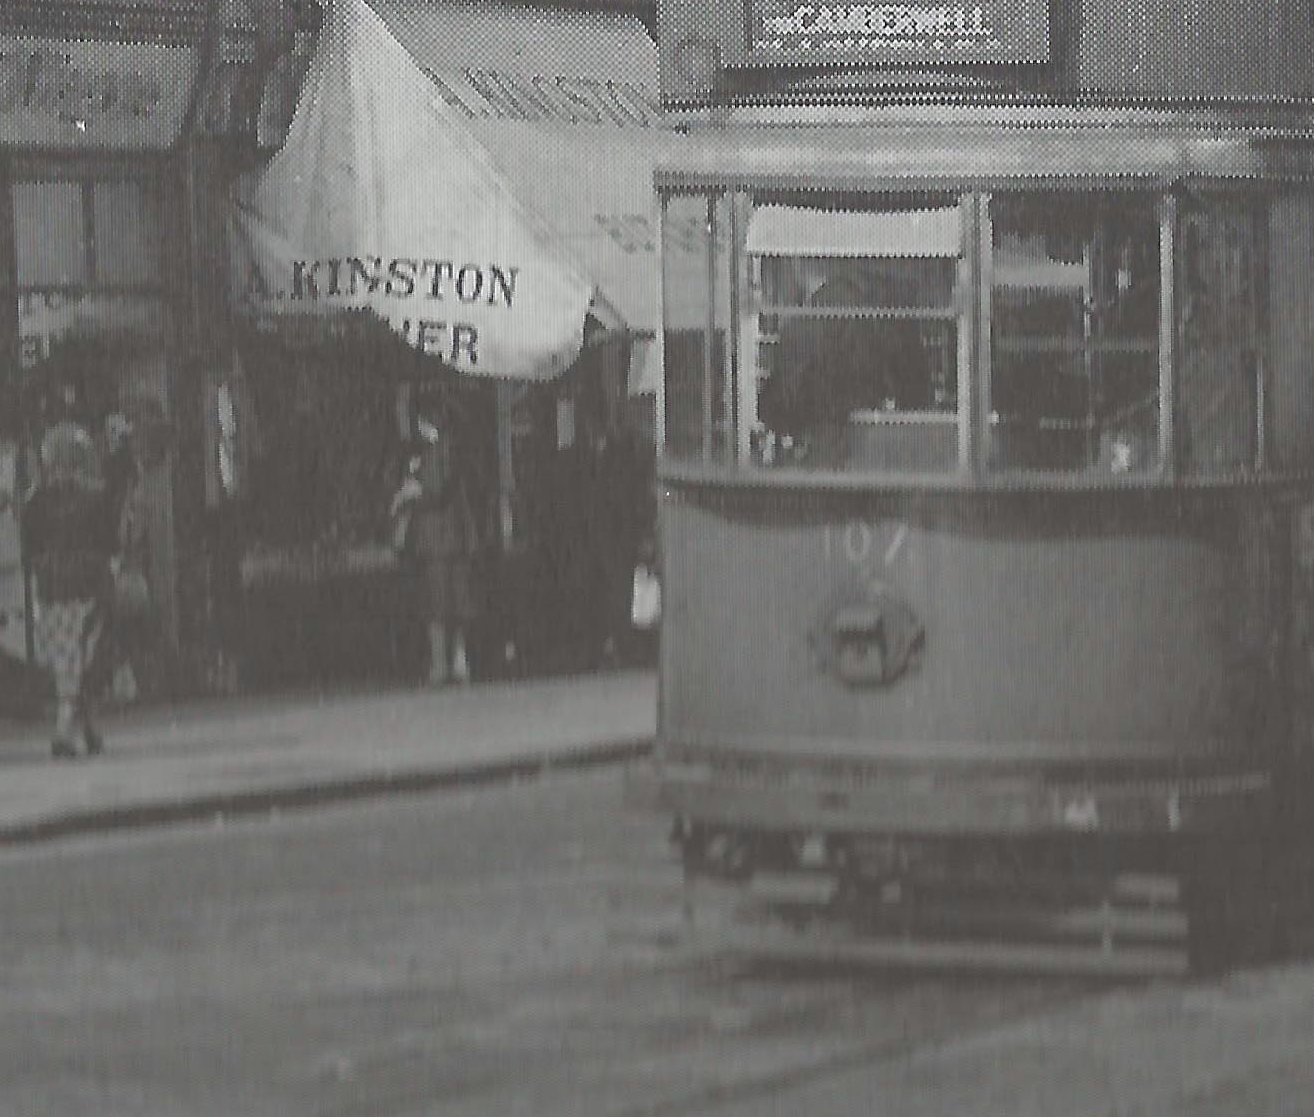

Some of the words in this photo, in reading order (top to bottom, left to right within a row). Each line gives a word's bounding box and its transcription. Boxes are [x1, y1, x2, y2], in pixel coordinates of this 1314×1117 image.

[794, 4, 993, 36] CAMBERWELL
[289, 250, 520, 311] KINSTON
[822, 518, 910, 568] 107
